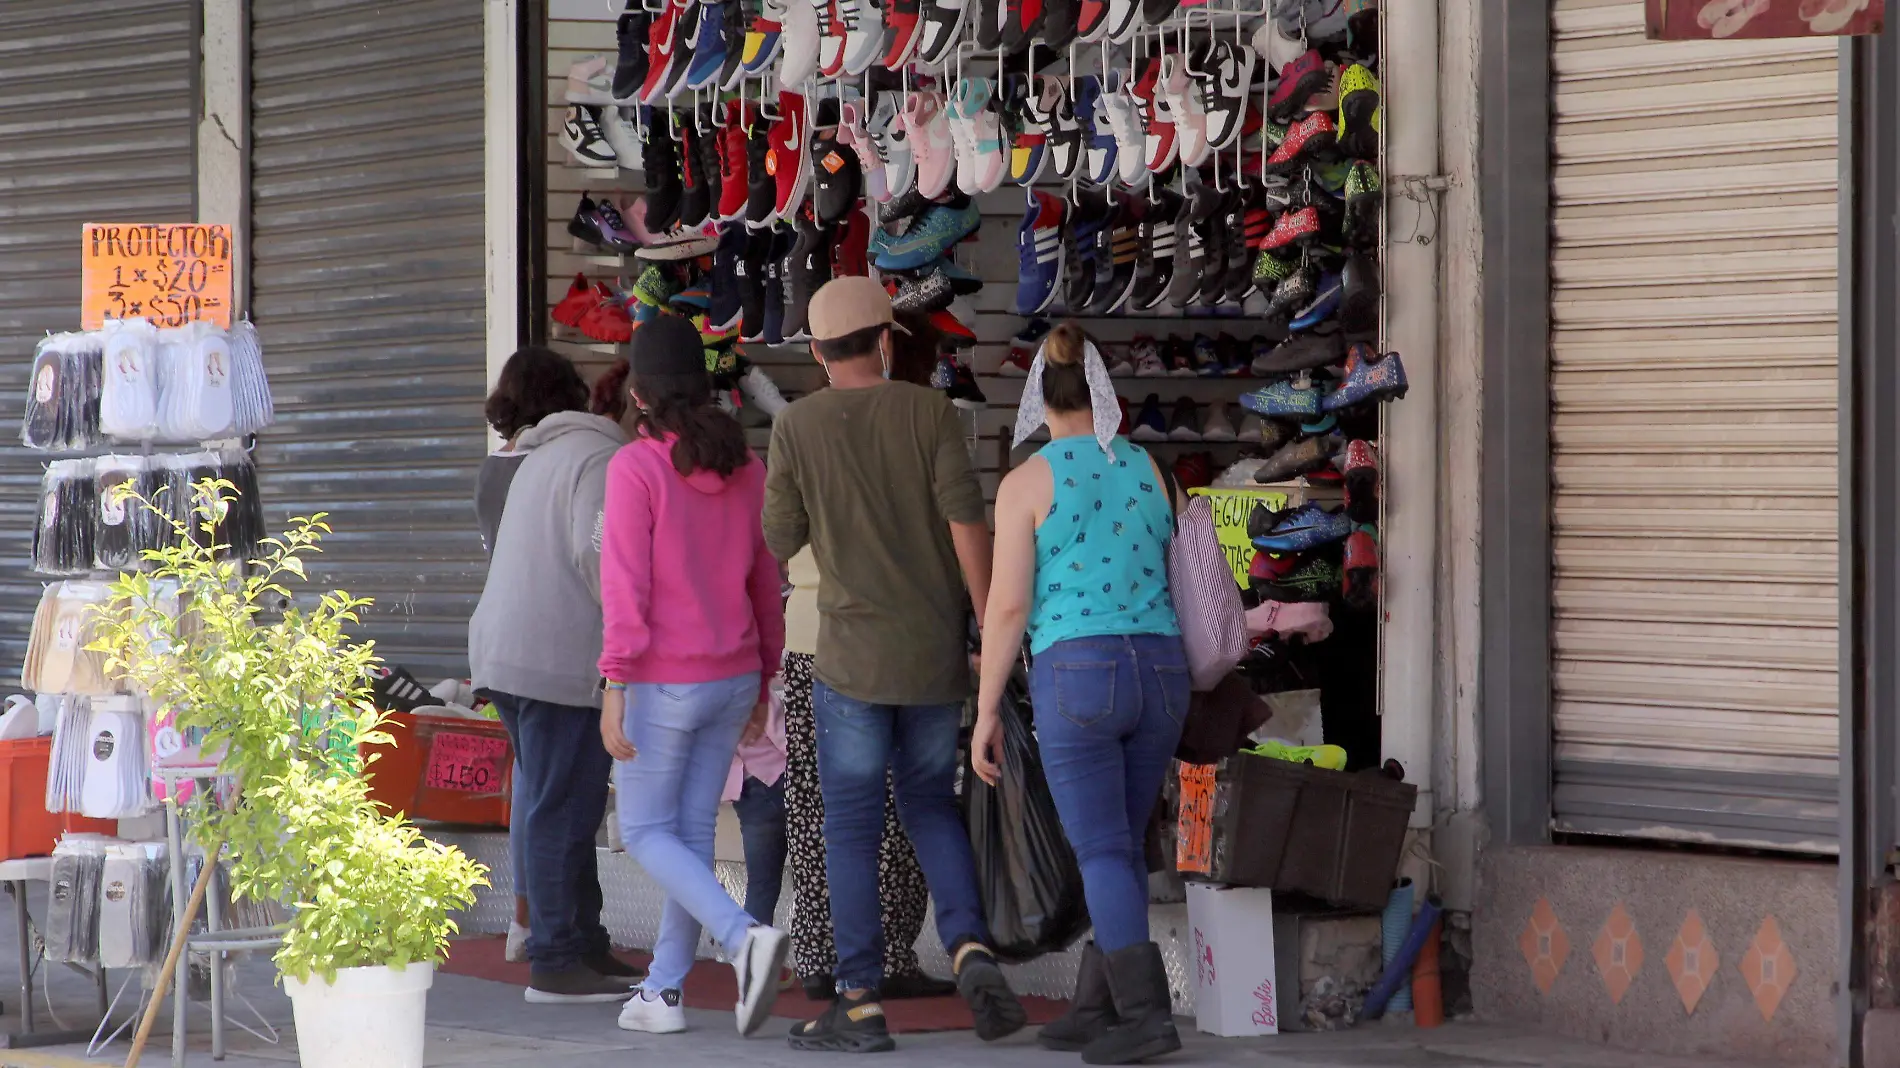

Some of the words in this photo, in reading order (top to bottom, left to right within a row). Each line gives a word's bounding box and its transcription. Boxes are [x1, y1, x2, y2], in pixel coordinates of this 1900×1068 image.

[92, 225, 230, 261] PROTECTOR
[109, 265, 131, 289] 1
[1251, 978, 1276, 1027] Barbie
